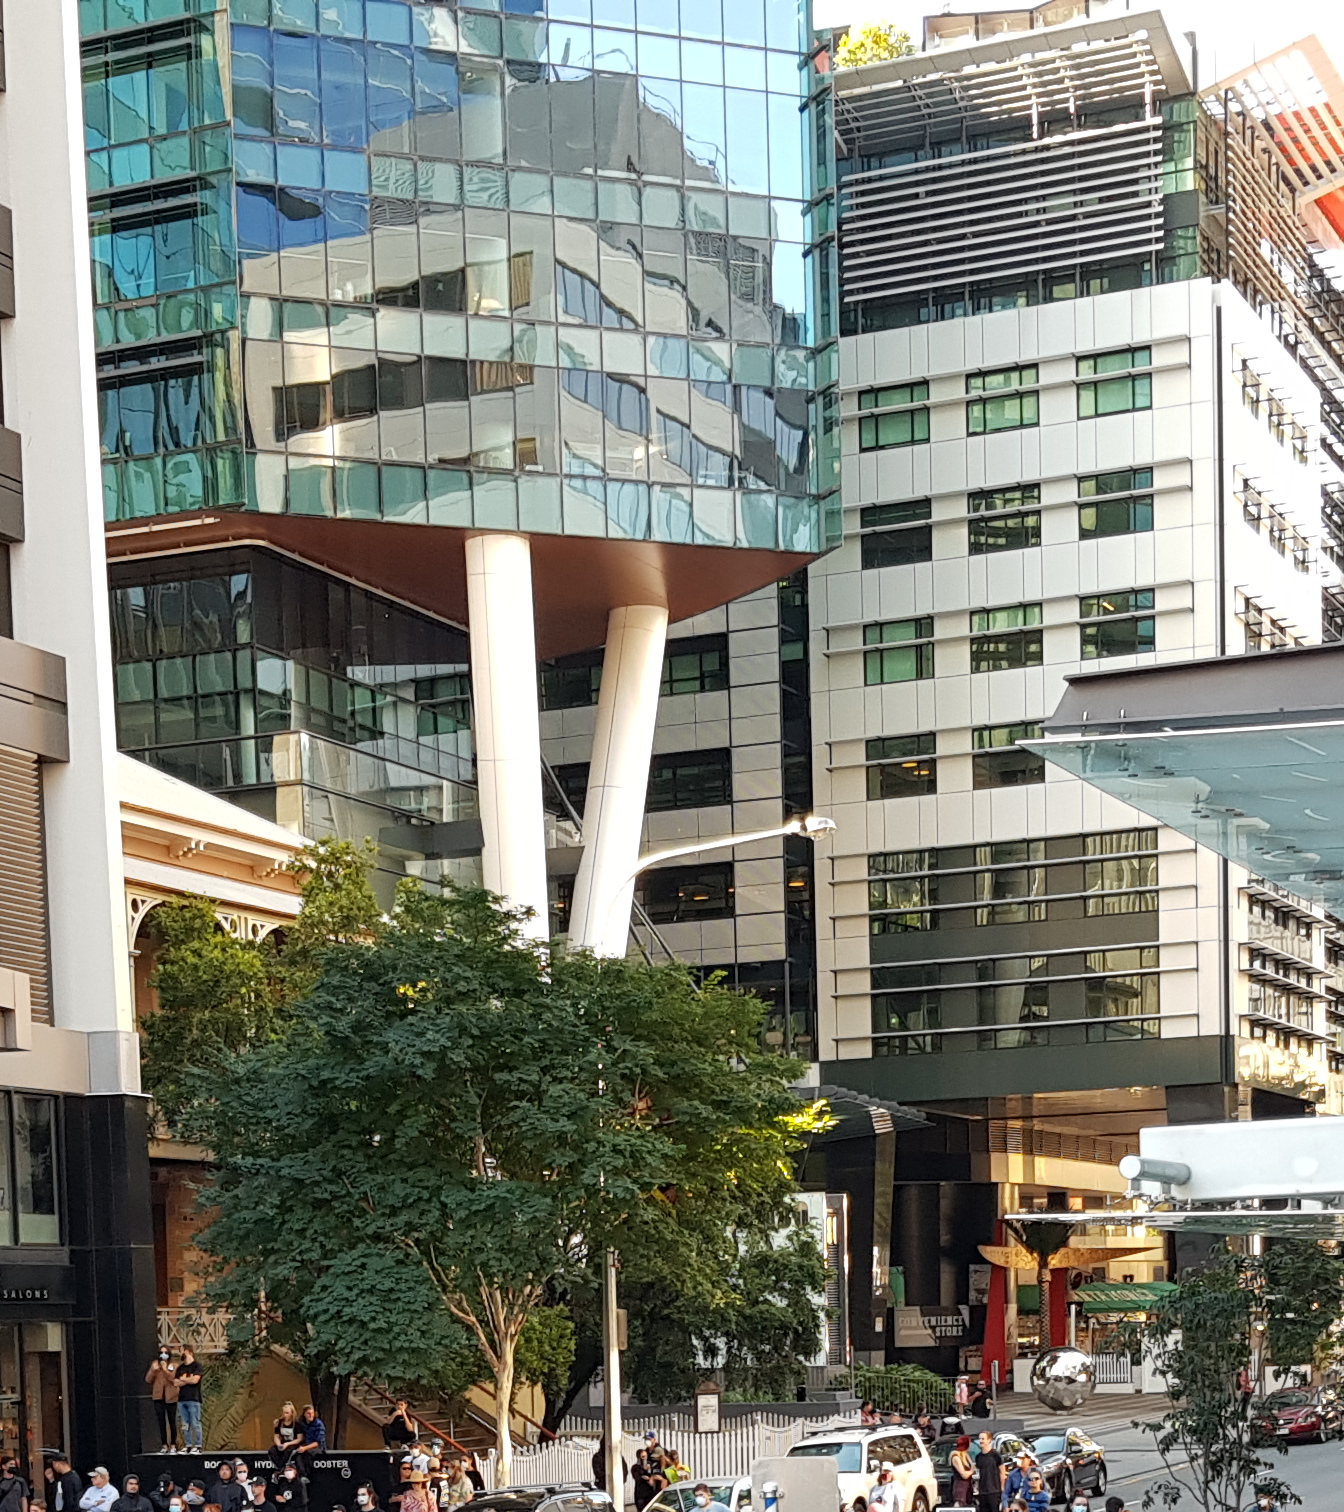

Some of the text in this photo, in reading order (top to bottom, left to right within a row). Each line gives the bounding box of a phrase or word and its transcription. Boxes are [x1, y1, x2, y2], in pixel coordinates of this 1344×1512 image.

[3, 1290, 49, 1299] SALONS
[935, 1326, 963, 1337] STORE
[313, 1460, 349, 1469] OOSTER
